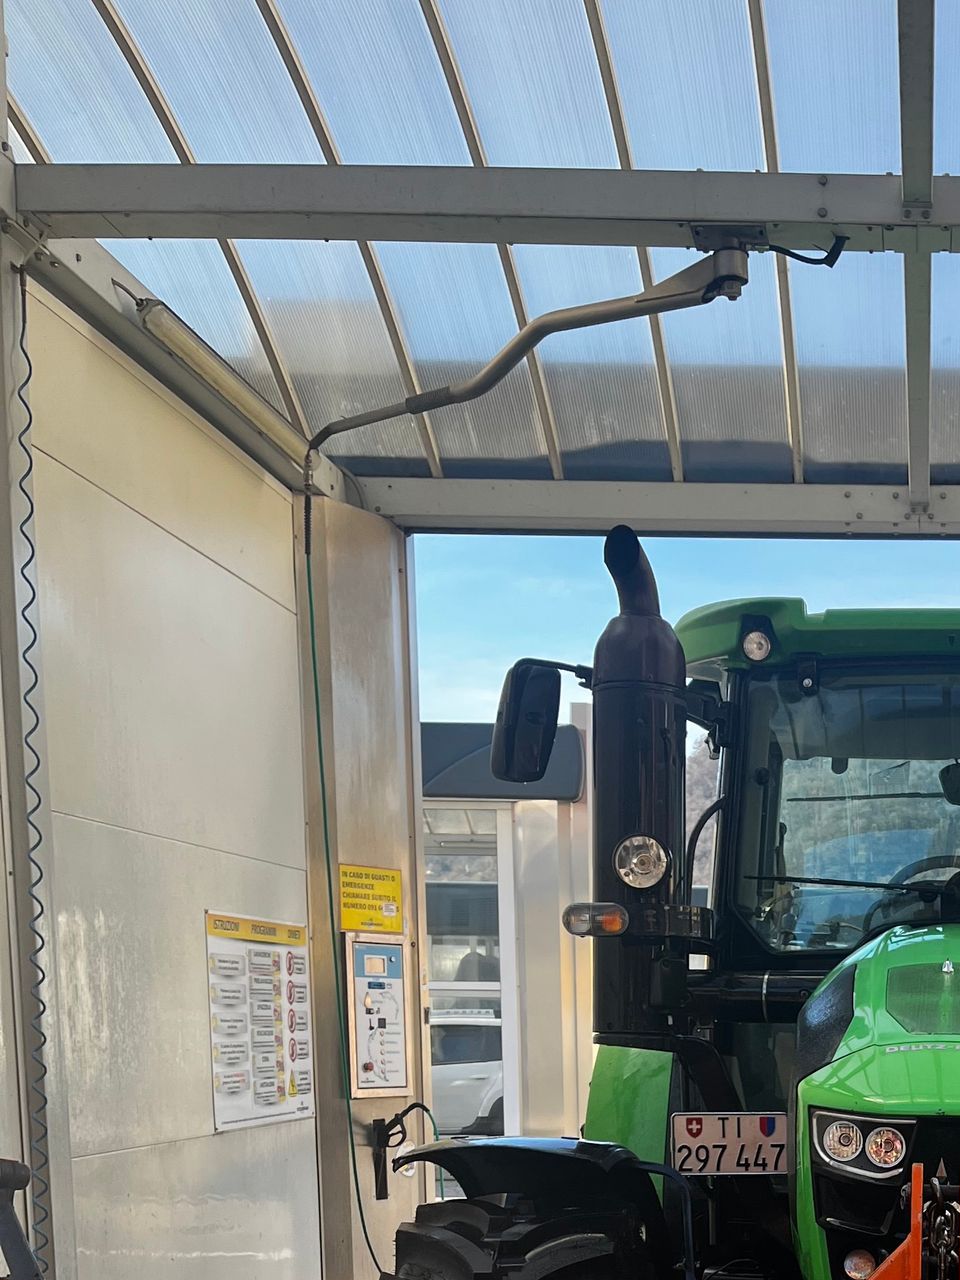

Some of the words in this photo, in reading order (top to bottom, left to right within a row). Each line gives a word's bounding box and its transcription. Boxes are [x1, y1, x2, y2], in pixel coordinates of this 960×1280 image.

[718, 1117, 741, 1138] TI
[677, 1144, 727, 1172] 297
[736, 1144, 785, 1171] 447
